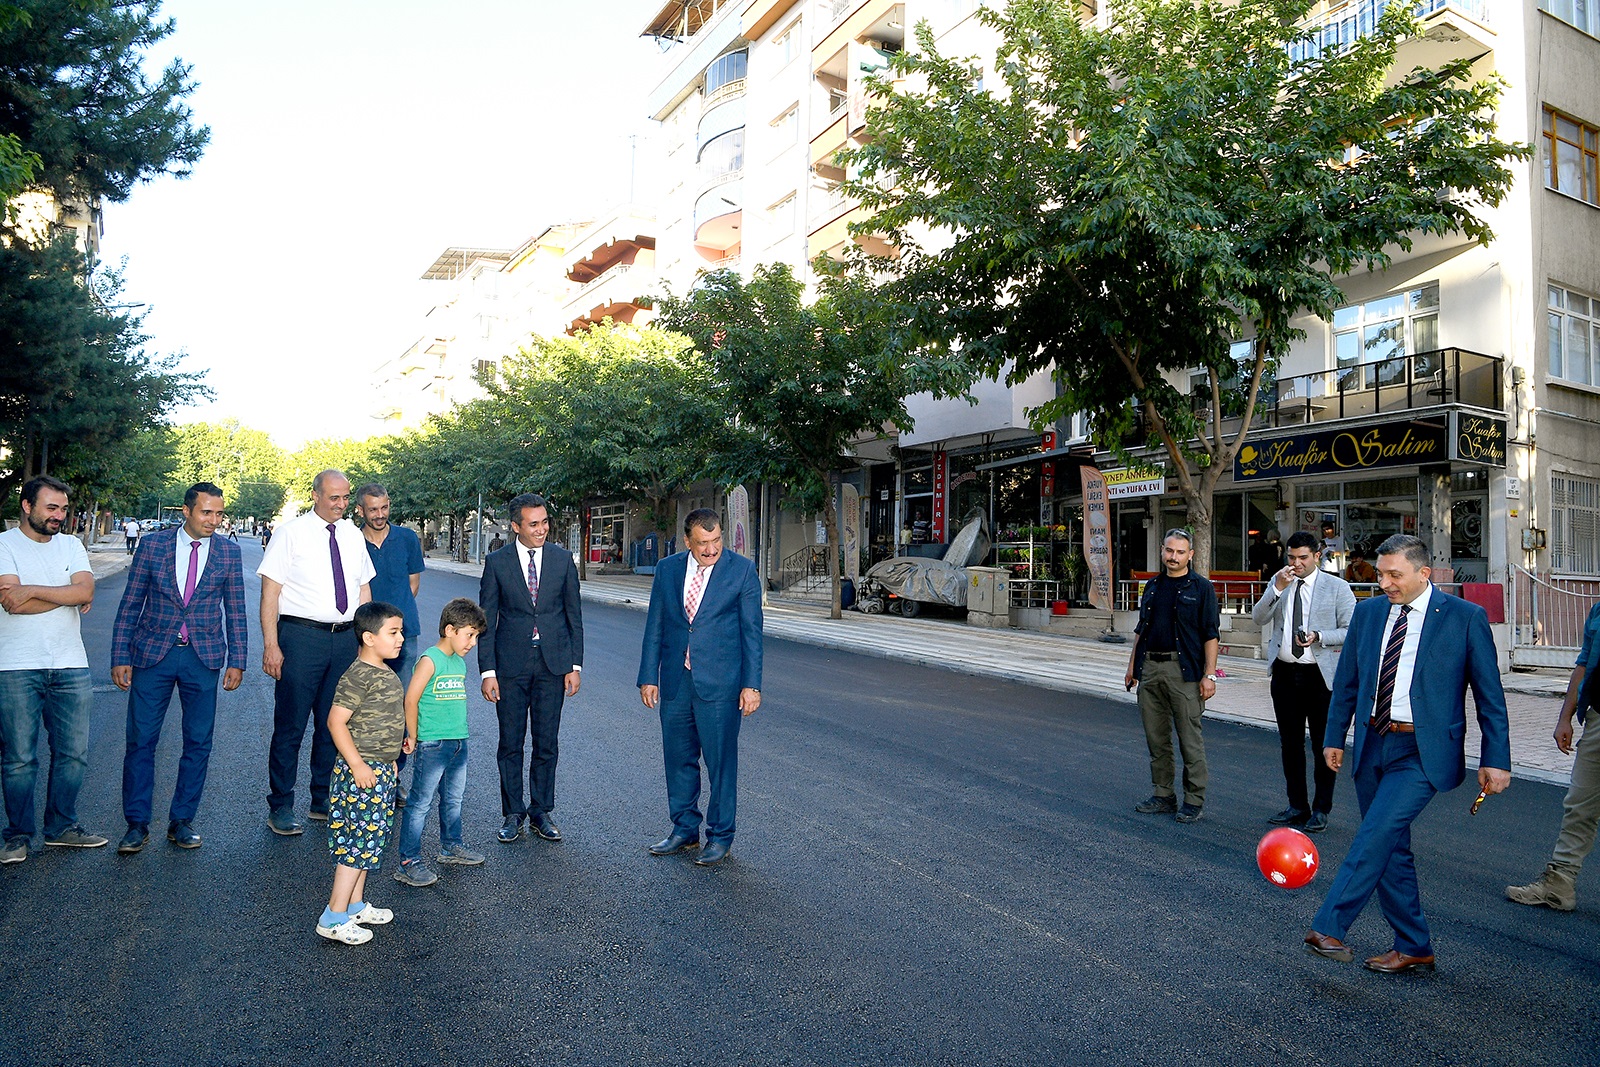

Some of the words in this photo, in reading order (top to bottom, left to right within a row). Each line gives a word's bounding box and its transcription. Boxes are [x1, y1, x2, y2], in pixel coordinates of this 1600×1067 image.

[1462, 418, 1501, 441] Kuaför
[1259, 440, 1327, 472] Kuaför
[1332, 429, 1437, 467] Salim
[1459, 433, 1505, 459] Salim
[1104, 472, 1125, 482] YNEP
[1126, 484, 1147, 493] YUFKA
[1149, 481, 1160, 491] EVİ
[1454, 567, 1478, 582] lim
